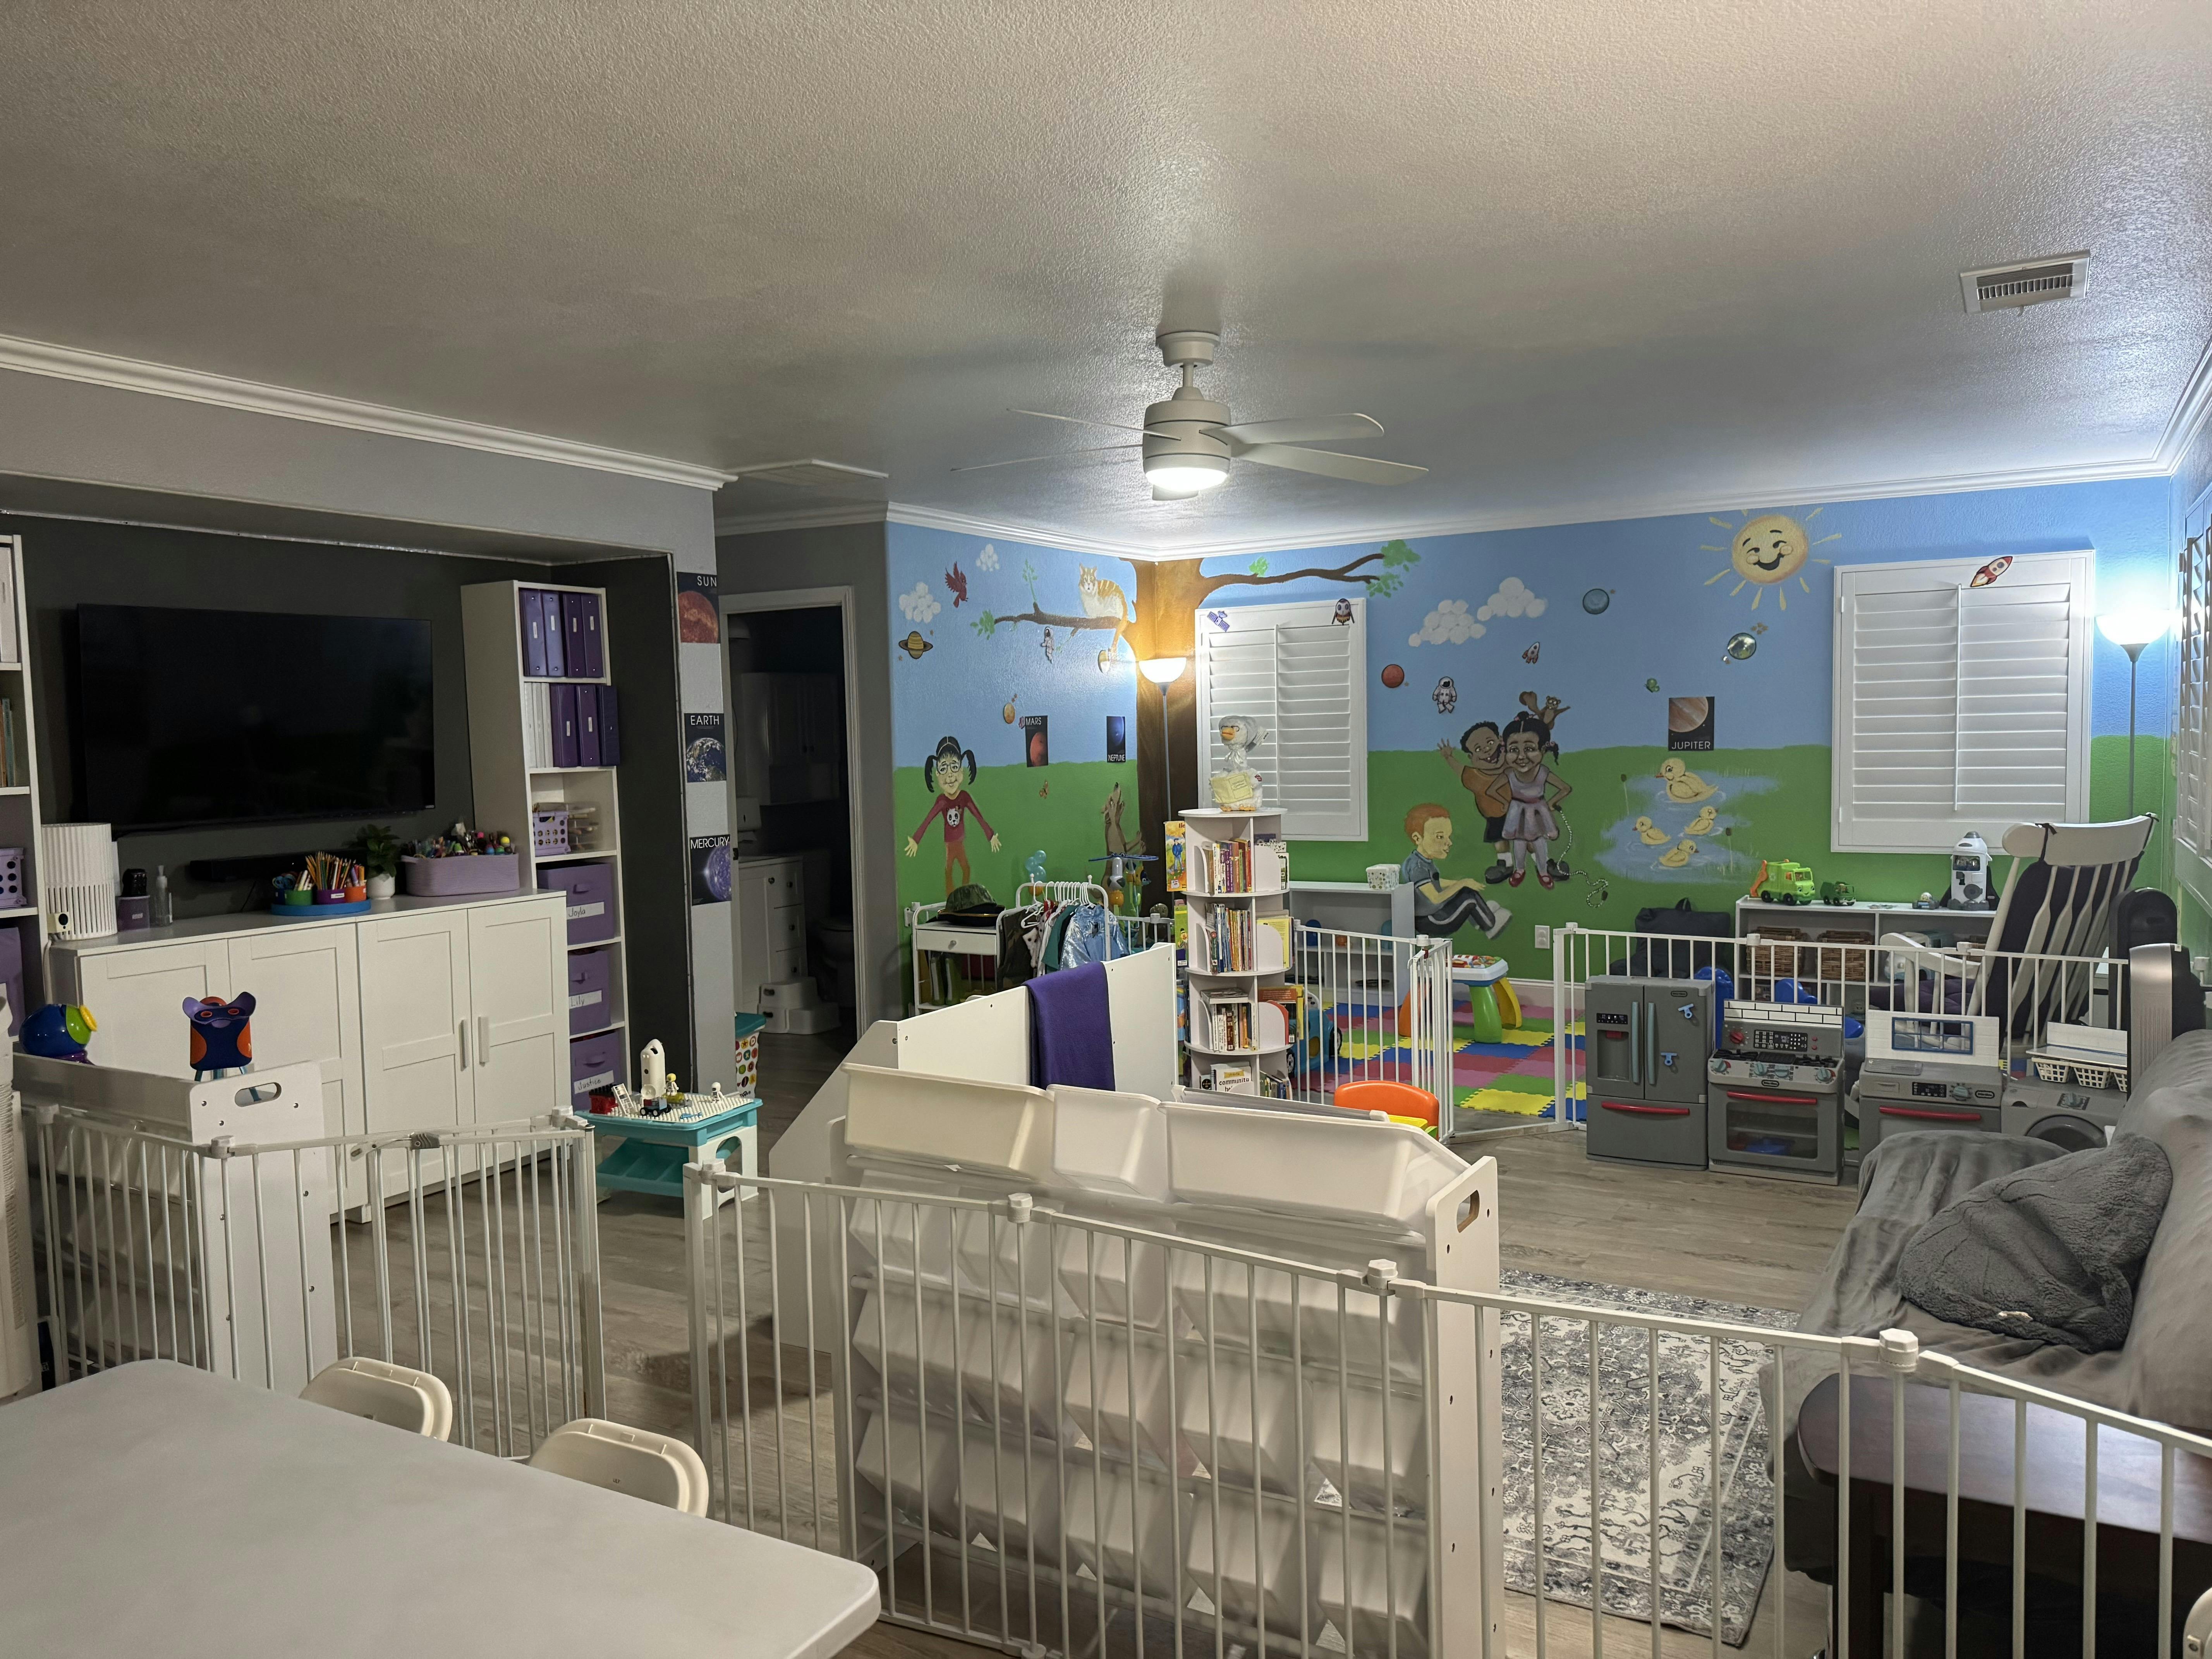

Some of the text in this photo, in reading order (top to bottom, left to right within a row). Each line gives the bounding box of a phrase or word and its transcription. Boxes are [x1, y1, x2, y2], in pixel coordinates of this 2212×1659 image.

[697, 575, 717, 587] SUN
[690, 715, 719, 725] EARTH
[1026, 717, 1041, 725] MARS
[1671, 741, 1711, 749] JUPITER
[690, 836, 729, 849] MERCURY
[571, 995, 585, 1007] Lily
[578, 1078, 601, 1091] Justice
